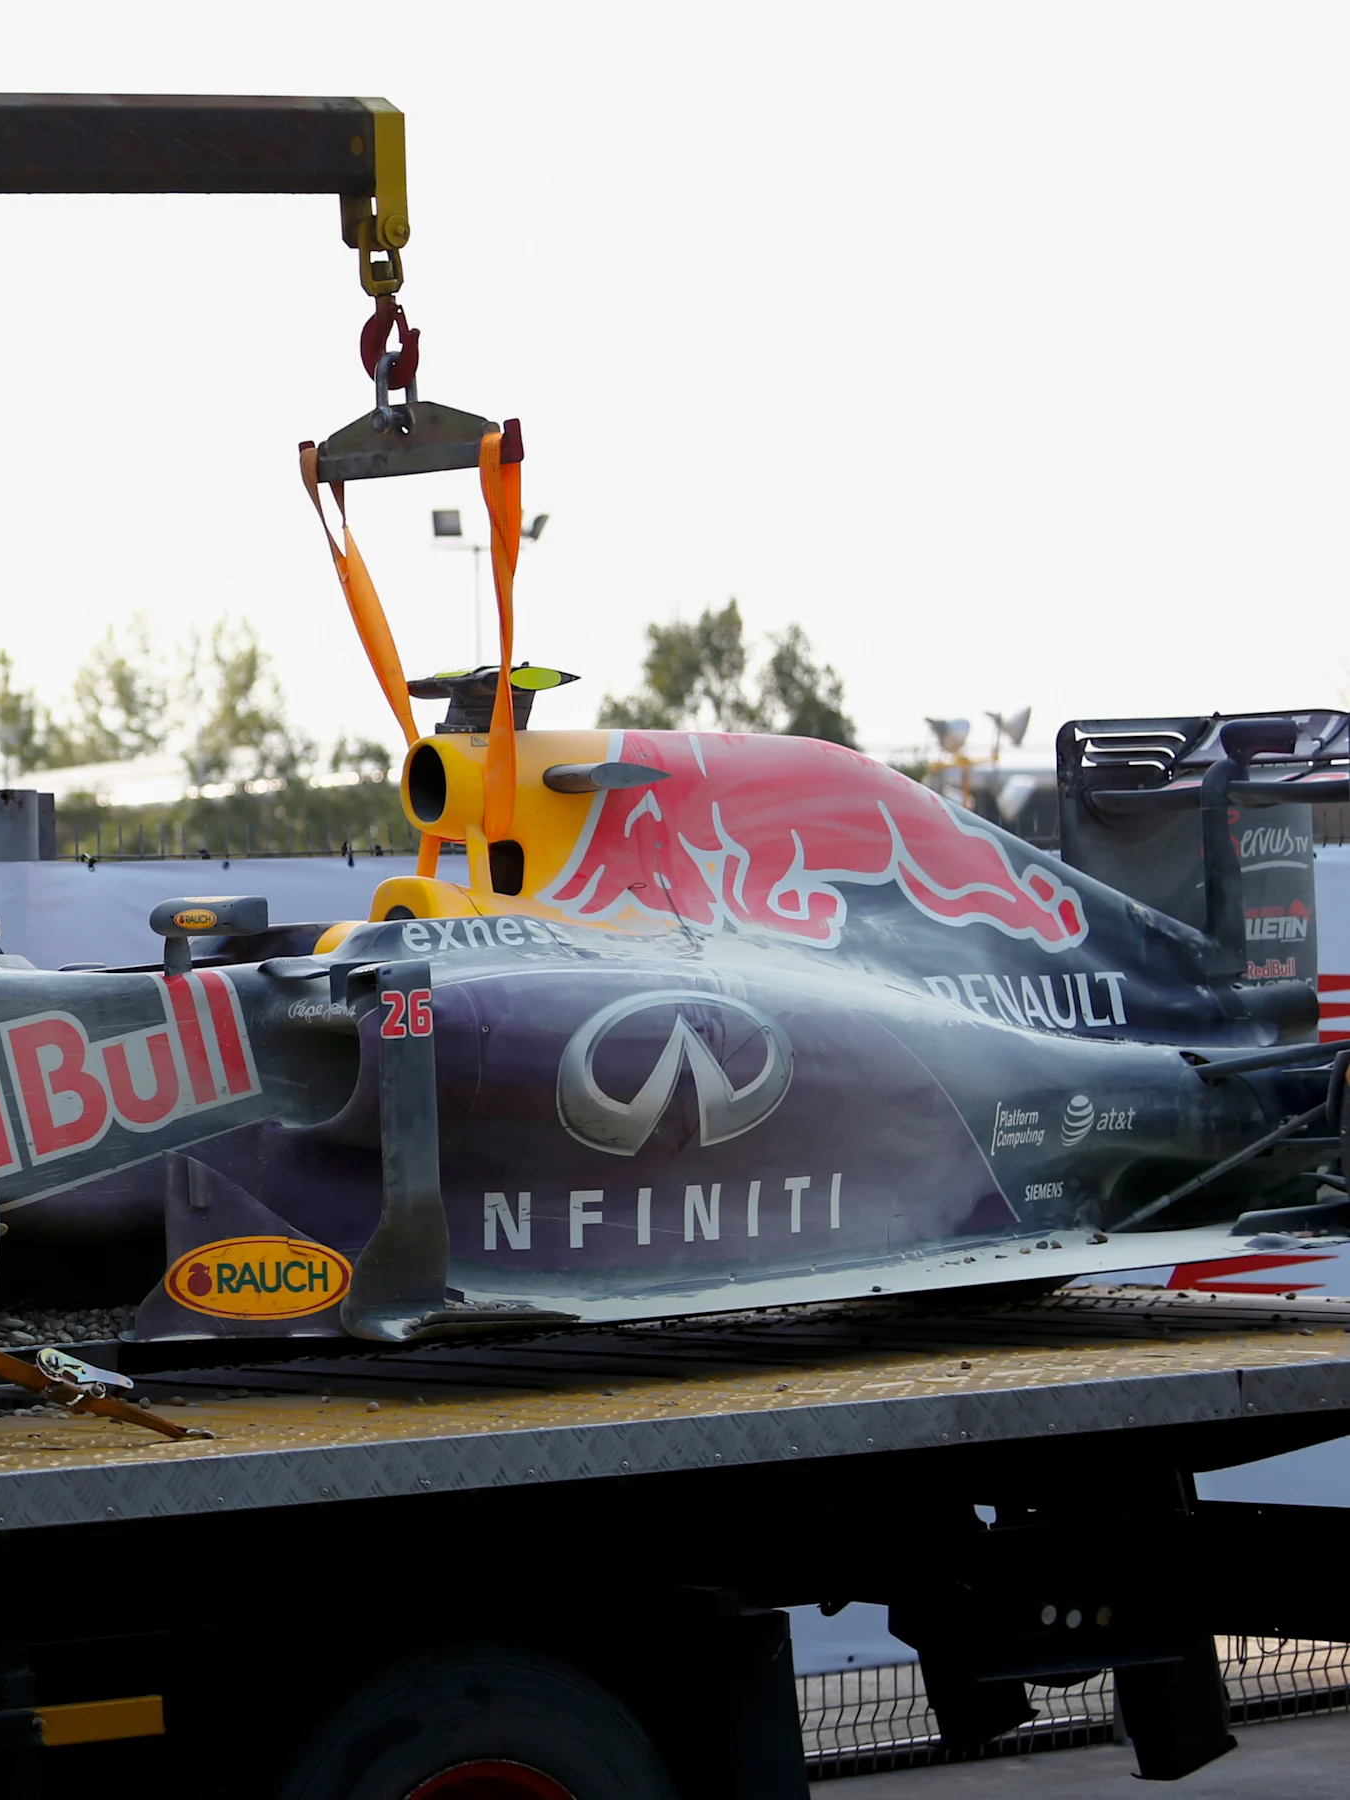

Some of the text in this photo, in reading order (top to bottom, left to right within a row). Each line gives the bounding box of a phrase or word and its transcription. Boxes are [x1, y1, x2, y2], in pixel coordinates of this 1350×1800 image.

[1295, 836, 1308, 853] TV
[185, 915, 211, 924] RAUCH
[401, 917, 574, 952] exness
[1247, 957, 1296, 980] Red Bull
[288, 999, 323, 1024] Pepe
[923, 971, 1128, 1029] RENAULT
[381, 988, 433, 1039] 26
[0, 970, 261, 1166] Bull
[1000, 1109, 1039, 1128] Platform
[1096, 1107, 1136, 1131] at&t
[996, 1127, 1046, 1149] Computing
[1025, 1181, 1064, 1202] SIEMENS
[483, 1172, 842, 1251] NFINITI
[216, 1260, 329, 1294] RAUCH
